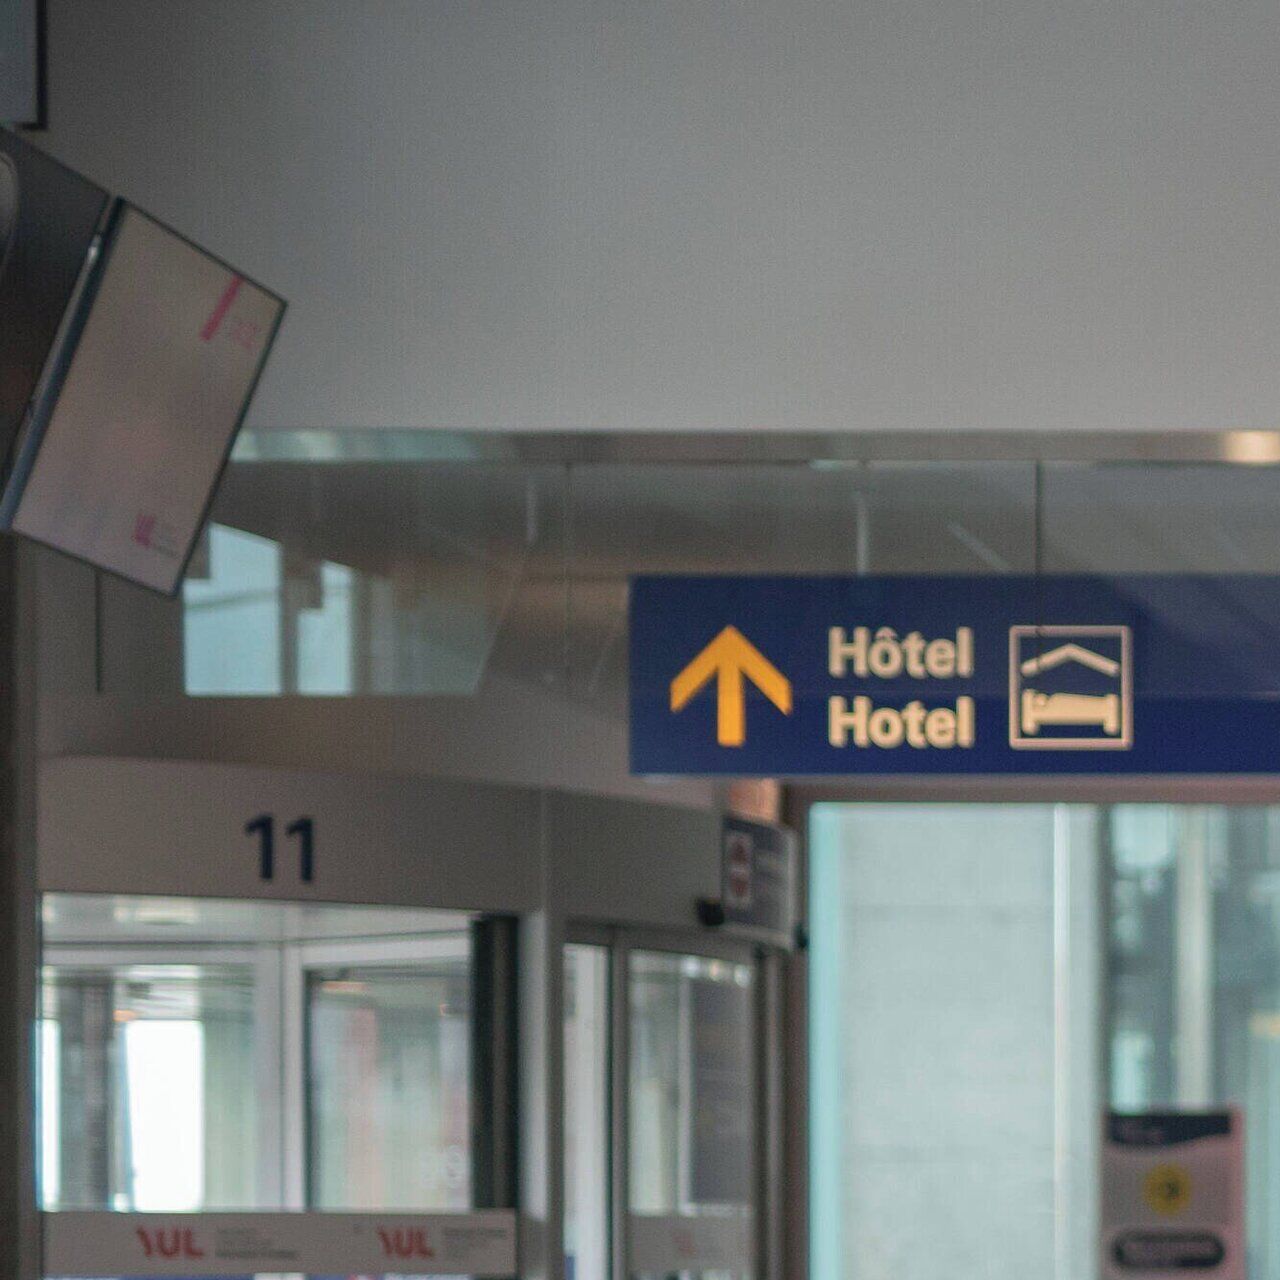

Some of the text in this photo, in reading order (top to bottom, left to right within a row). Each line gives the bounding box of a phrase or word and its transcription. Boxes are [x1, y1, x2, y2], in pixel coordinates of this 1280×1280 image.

[828, 625, 974, 678] Hôtel
[828, 696, 975, 749] Hotel
[244, 813, 313, 884] 11
